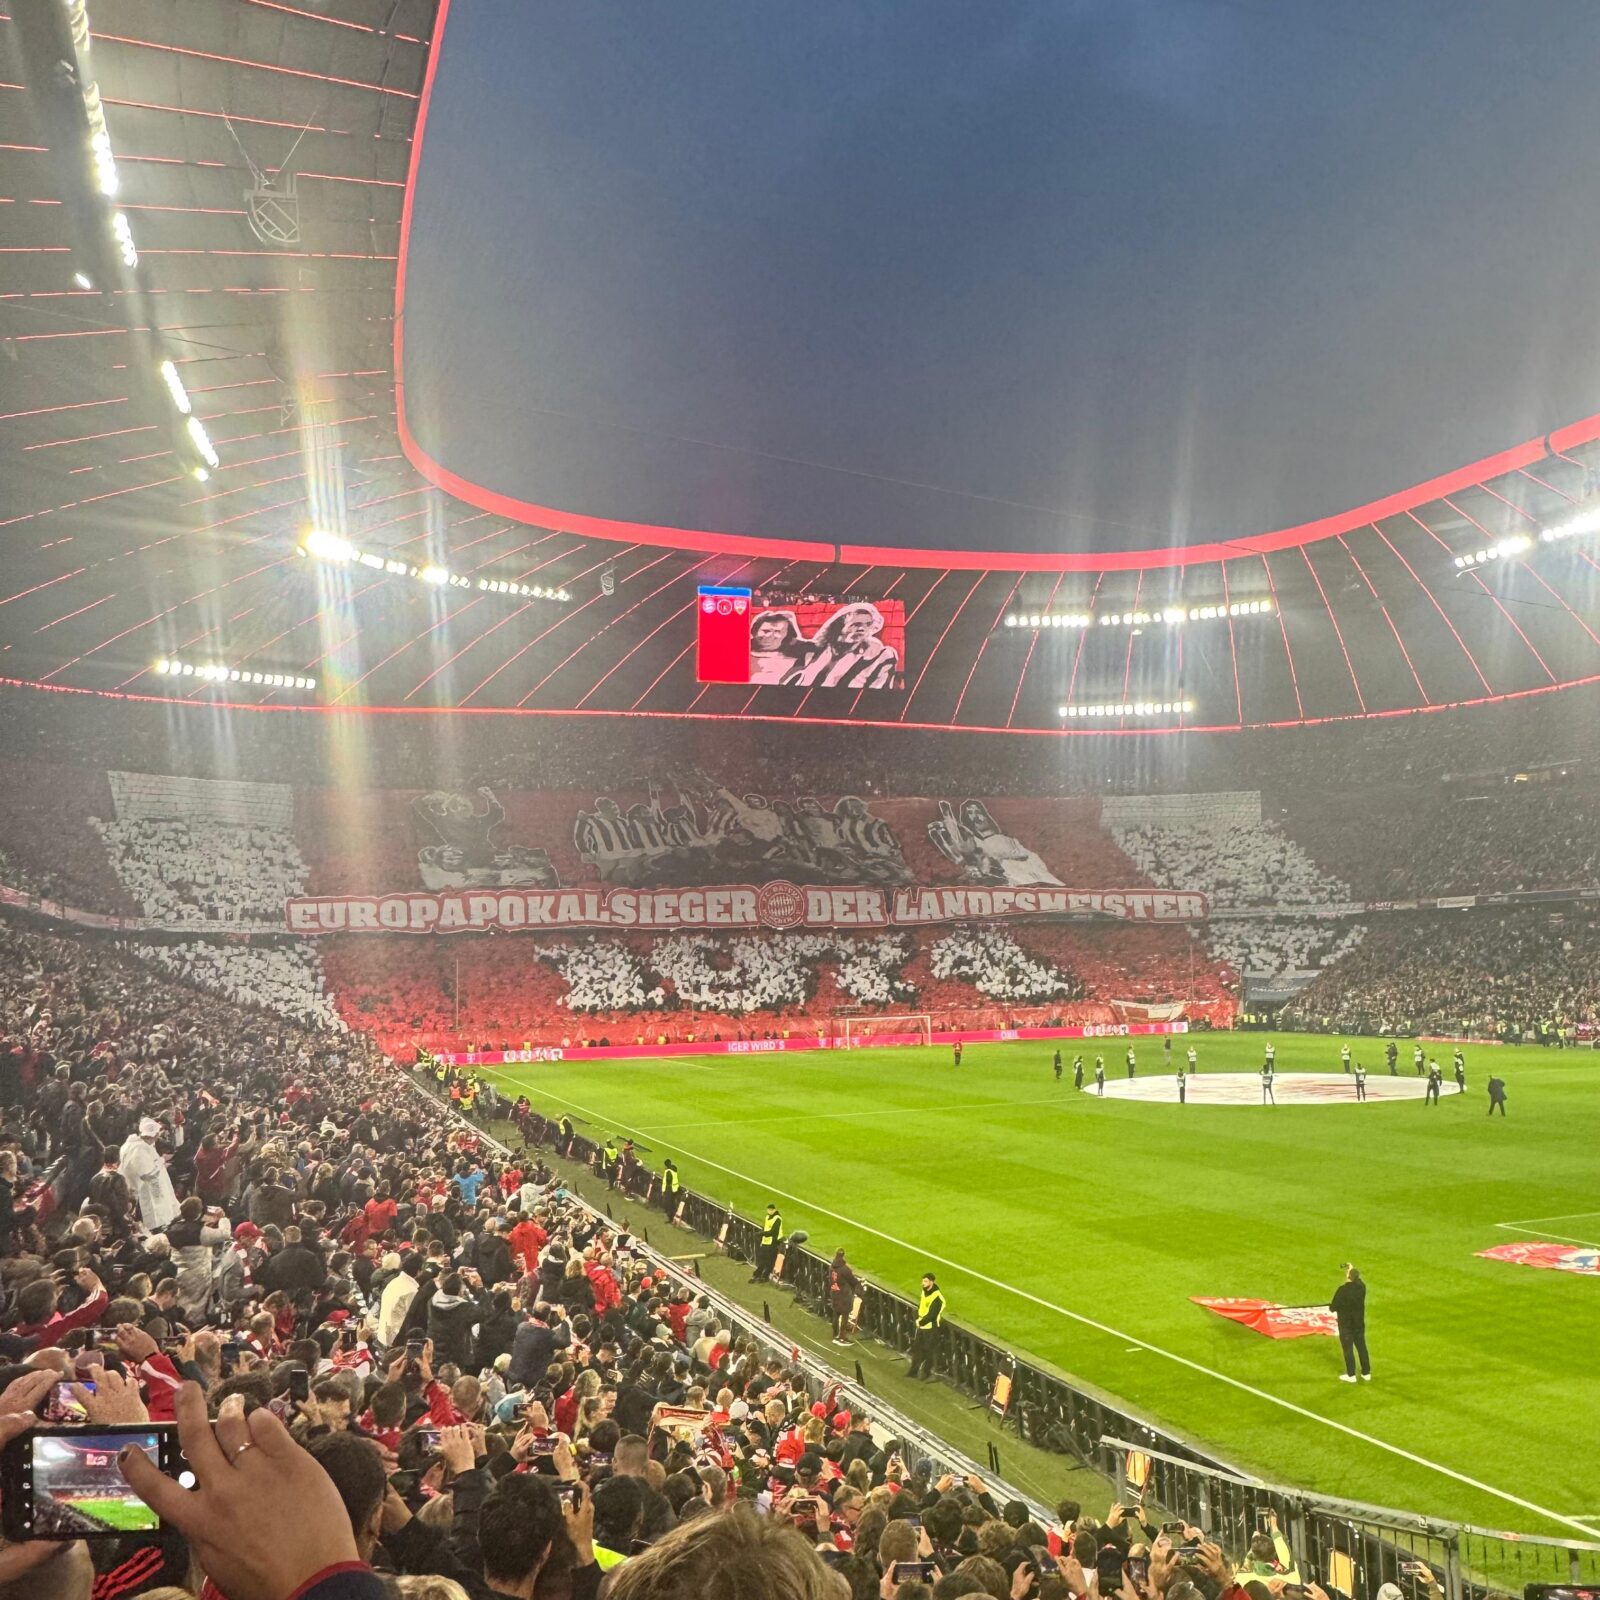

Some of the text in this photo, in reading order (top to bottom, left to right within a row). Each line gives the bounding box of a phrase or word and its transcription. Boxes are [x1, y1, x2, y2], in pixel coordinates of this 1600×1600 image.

[290, 890, 1203, 928] EUROPAPOKALSIEGER DER LANDESMEISTER
